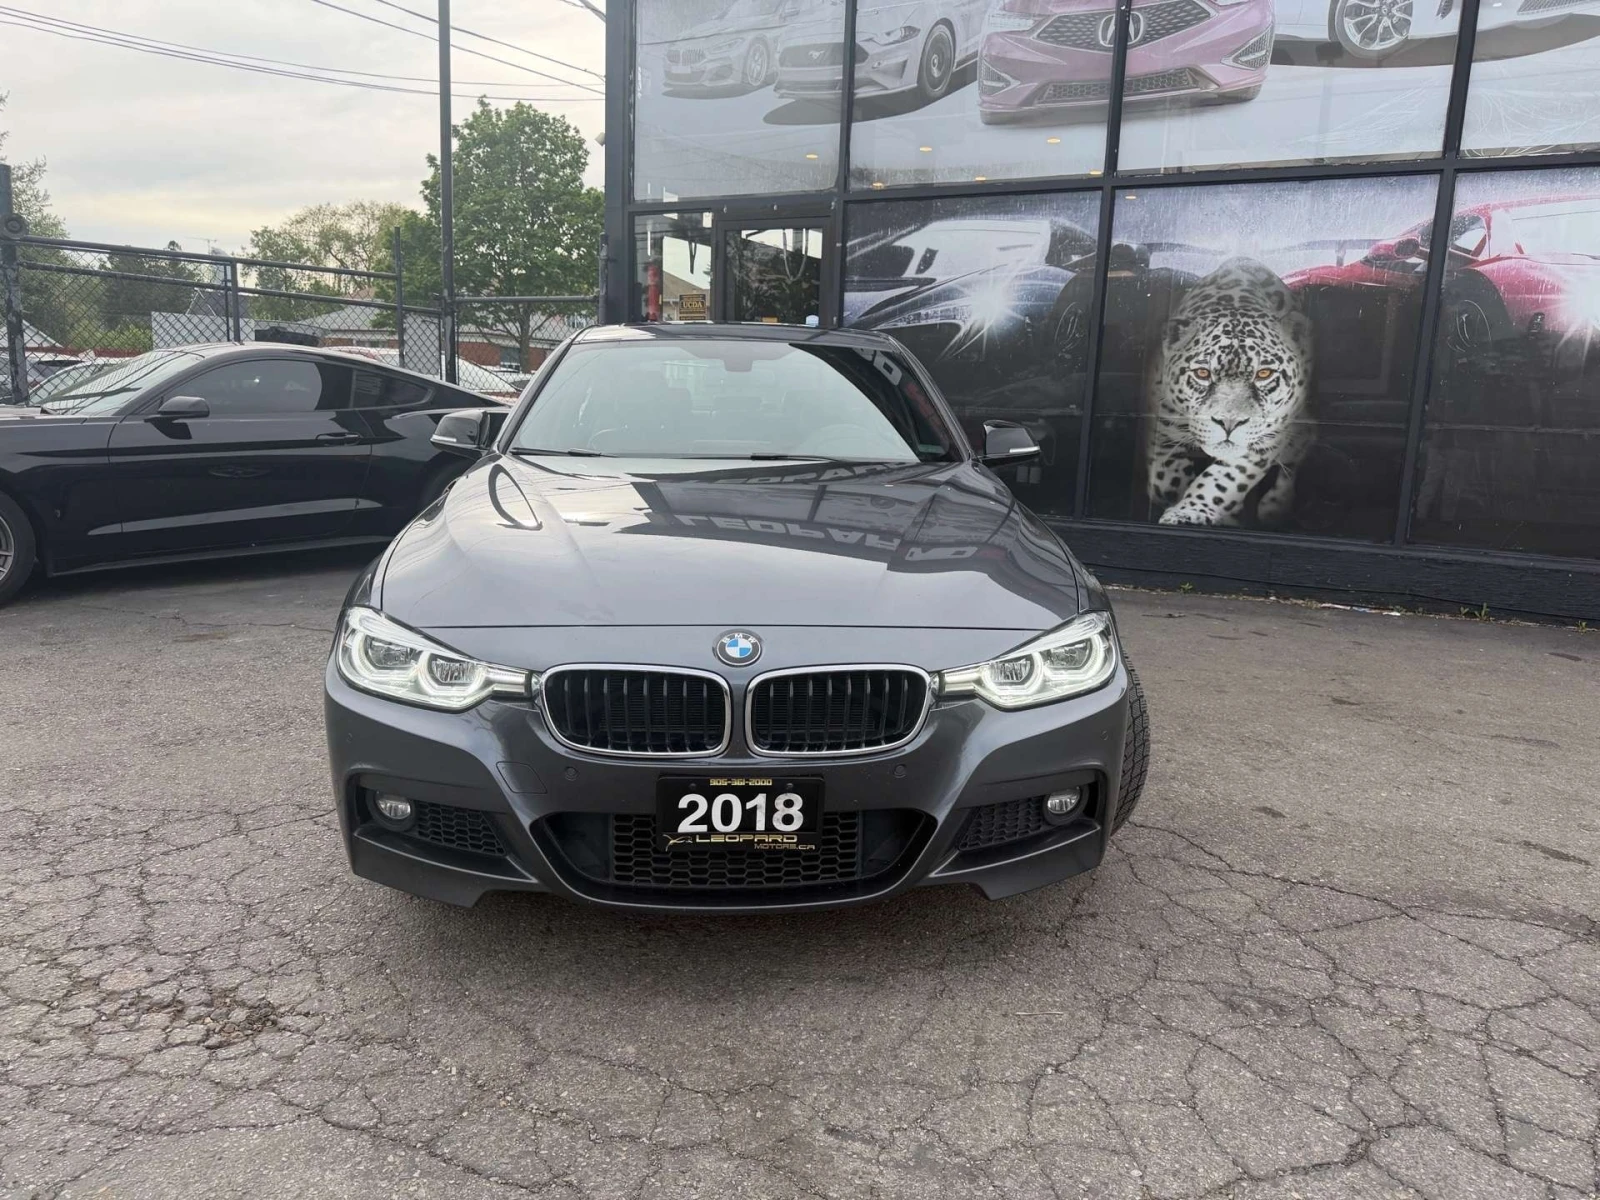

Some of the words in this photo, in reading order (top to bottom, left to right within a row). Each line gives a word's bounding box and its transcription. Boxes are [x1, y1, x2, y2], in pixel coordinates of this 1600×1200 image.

[721, 633, 757, 644] BMW
[677, 793, 804, 833] 2018
[696, 834, 798, 843] LEOPARD
